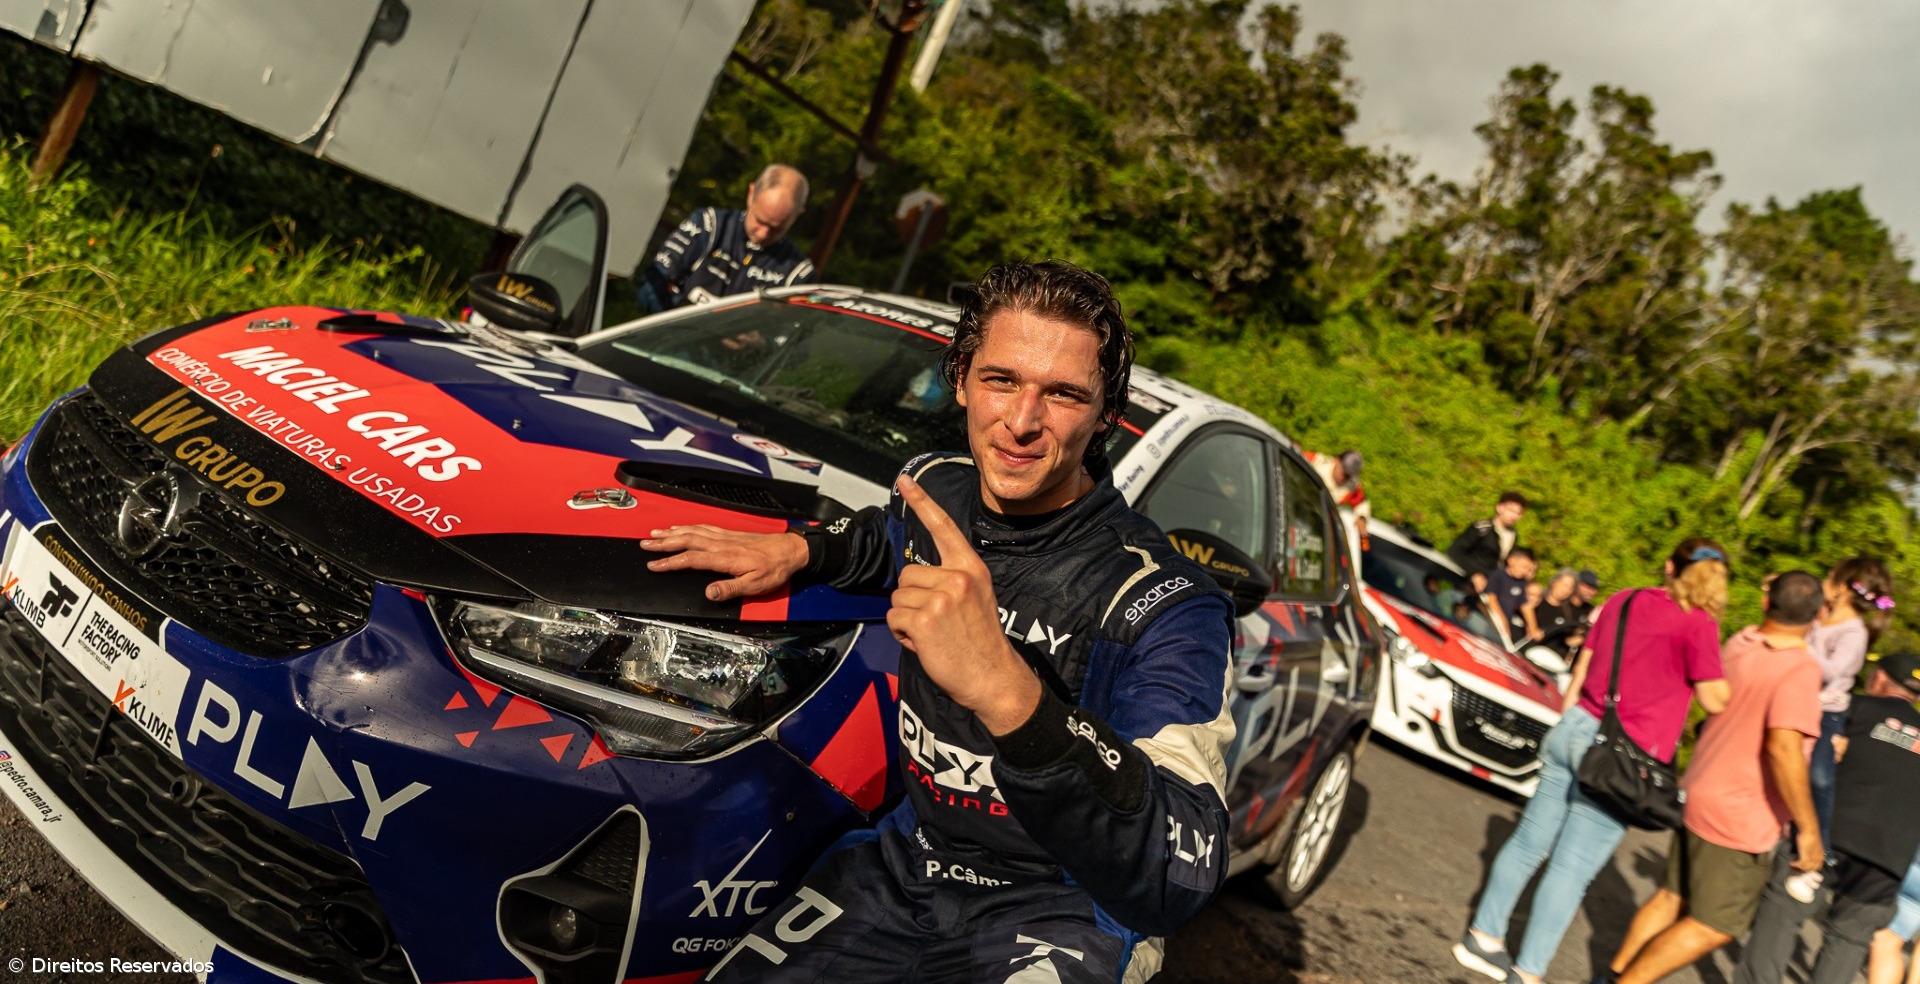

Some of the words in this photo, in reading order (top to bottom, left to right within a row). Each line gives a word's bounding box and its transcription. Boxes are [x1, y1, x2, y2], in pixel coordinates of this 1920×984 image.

[496, 274, 534, 297] IW
[219, 345, 370, 415] MACIEL
[346, 411, 482, 482] CARS
[131, 388, 217, 444] IW
[175, 435, 286, 507] GRUPO
[155, 346, 231, 395] COMÉRCIO
[219, 388, 253, 413] DE
[247, 401, 351, 473] VIATURAS
[346, 466, 462, 535] USADAS
[1212, 560, 1250, 578] GRUPO
[1125, 577, 1190, 622] sparco
[81, 624, 121, 664] FACTORY
[90, 611, 109, 632] THE
[105, 624, 141, 660] RACING
[128, 696, 174, 749] KLIME
[187, 679, 432, 841] PLAY
[689, 828, 778, 918] XTC
[672, 937, 704, 954] QG
